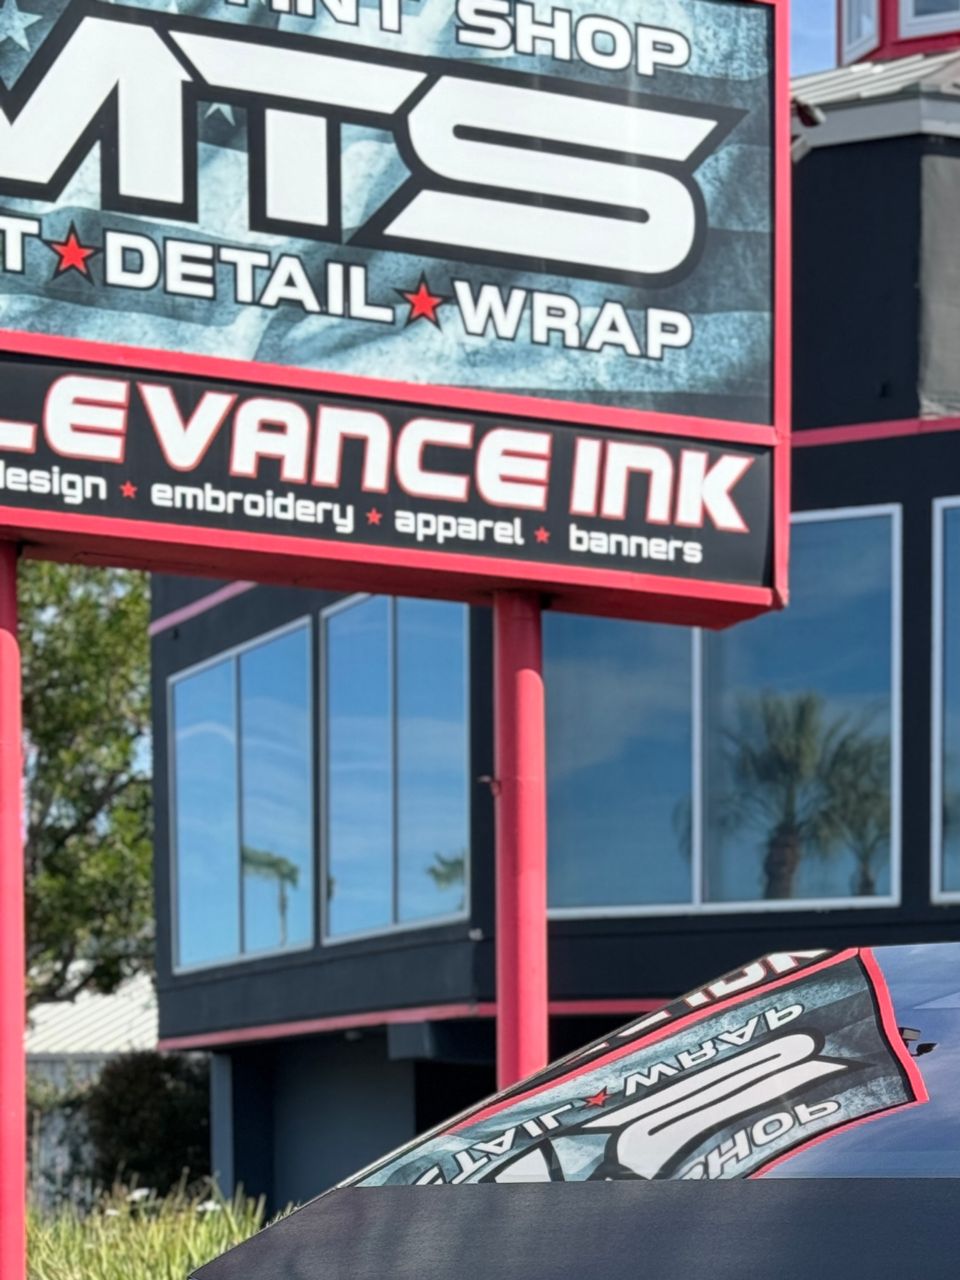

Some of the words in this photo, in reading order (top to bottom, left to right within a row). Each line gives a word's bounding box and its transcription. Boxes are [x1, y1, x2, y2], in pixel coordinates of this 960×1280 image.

[454, 0, 692, 77] SHOP
[0, 14, 721, 276] MTS
[104, 229, 395, 323] DETAIL
[451, 278, 694, 360] WRAP
[0, 372, 552, 512] EVANCE
[569, 436, 756, 534] INK
[0, 460, 107, 504] esign
[150, 475, 355, 534] embroidery
[395, 509, 525, 545] apparel
[569, 522, 703, 564] banners
